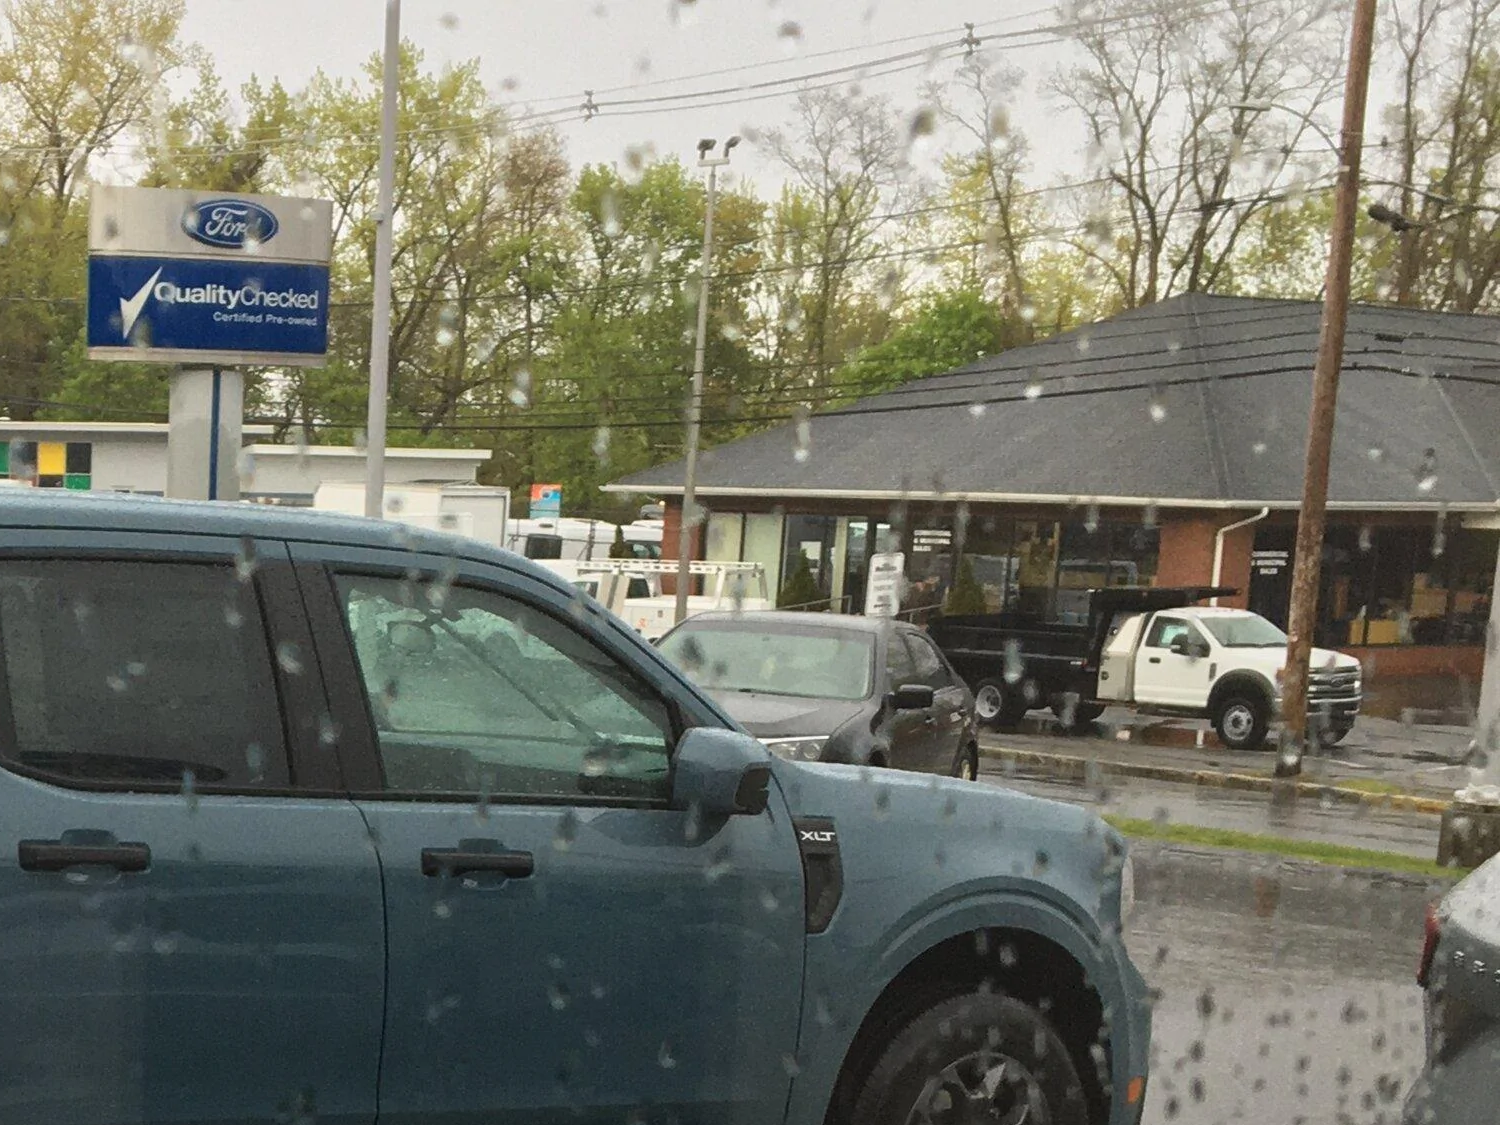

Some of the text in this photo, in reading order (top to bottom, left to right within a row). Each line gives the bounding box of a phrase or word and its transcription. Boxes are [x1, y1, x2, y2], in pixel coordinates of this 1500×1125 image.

[213, 311, 318, 326] Certified Pre-owned
[800, 830, 836, 842] XLT
